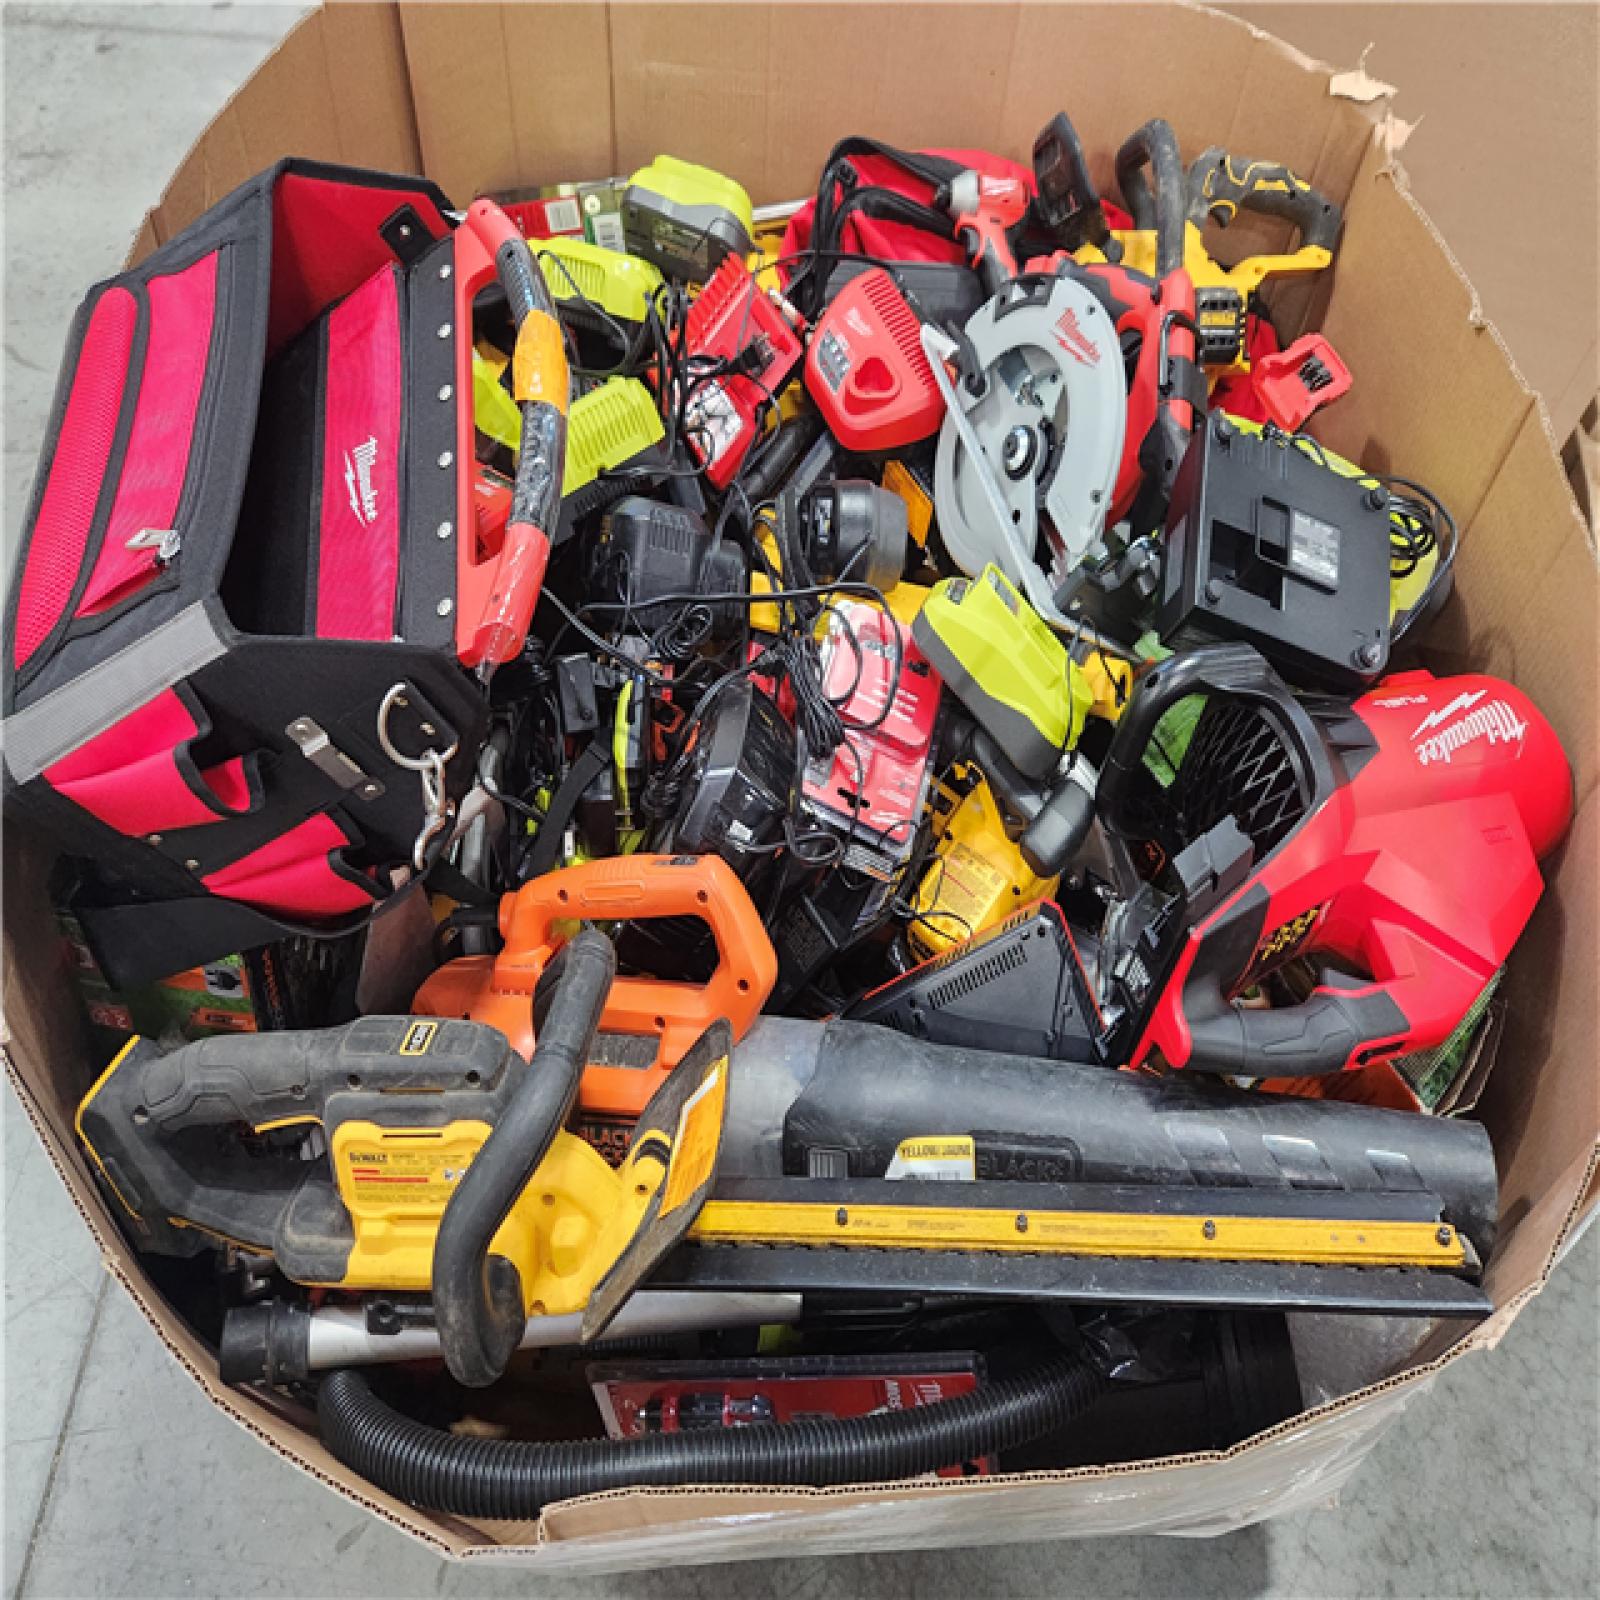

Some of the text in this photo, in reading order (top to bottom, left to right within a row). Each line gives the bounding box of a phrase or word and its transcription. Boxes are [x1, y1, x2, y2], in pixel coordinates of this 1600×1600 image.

[1053, 306, 1101, 363] Milwaukee
[352, 435, 378, 523] Milwaukee
[1415, 699, 1528, 765] Milwaukee
